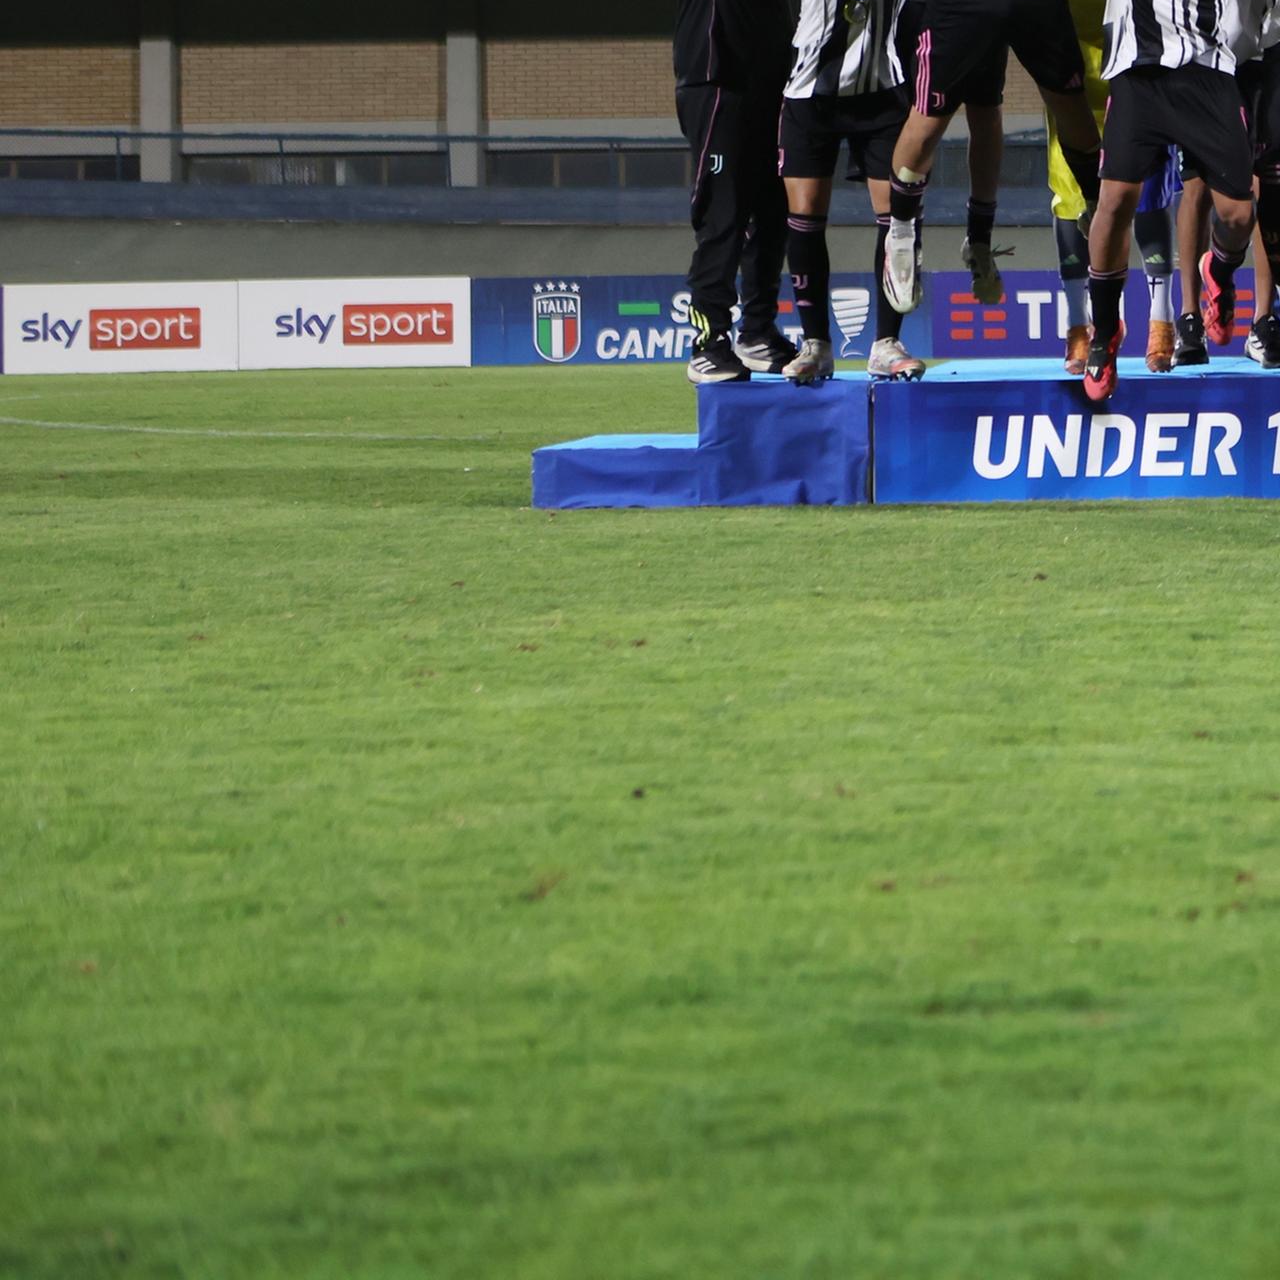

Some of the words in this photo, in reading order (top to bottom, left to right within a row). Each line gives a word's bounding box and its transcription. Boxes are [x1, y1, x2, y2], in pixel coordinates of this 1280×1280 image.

[275, 307, 336, 344] sky
[349, 308, 446, 342] sport
[537, 300, 577, 314] ITALIA
[21, 312, 82, 349] sky
[96, 313, 194, 347] sport
[973, 412, 1242, 479] UNDER
